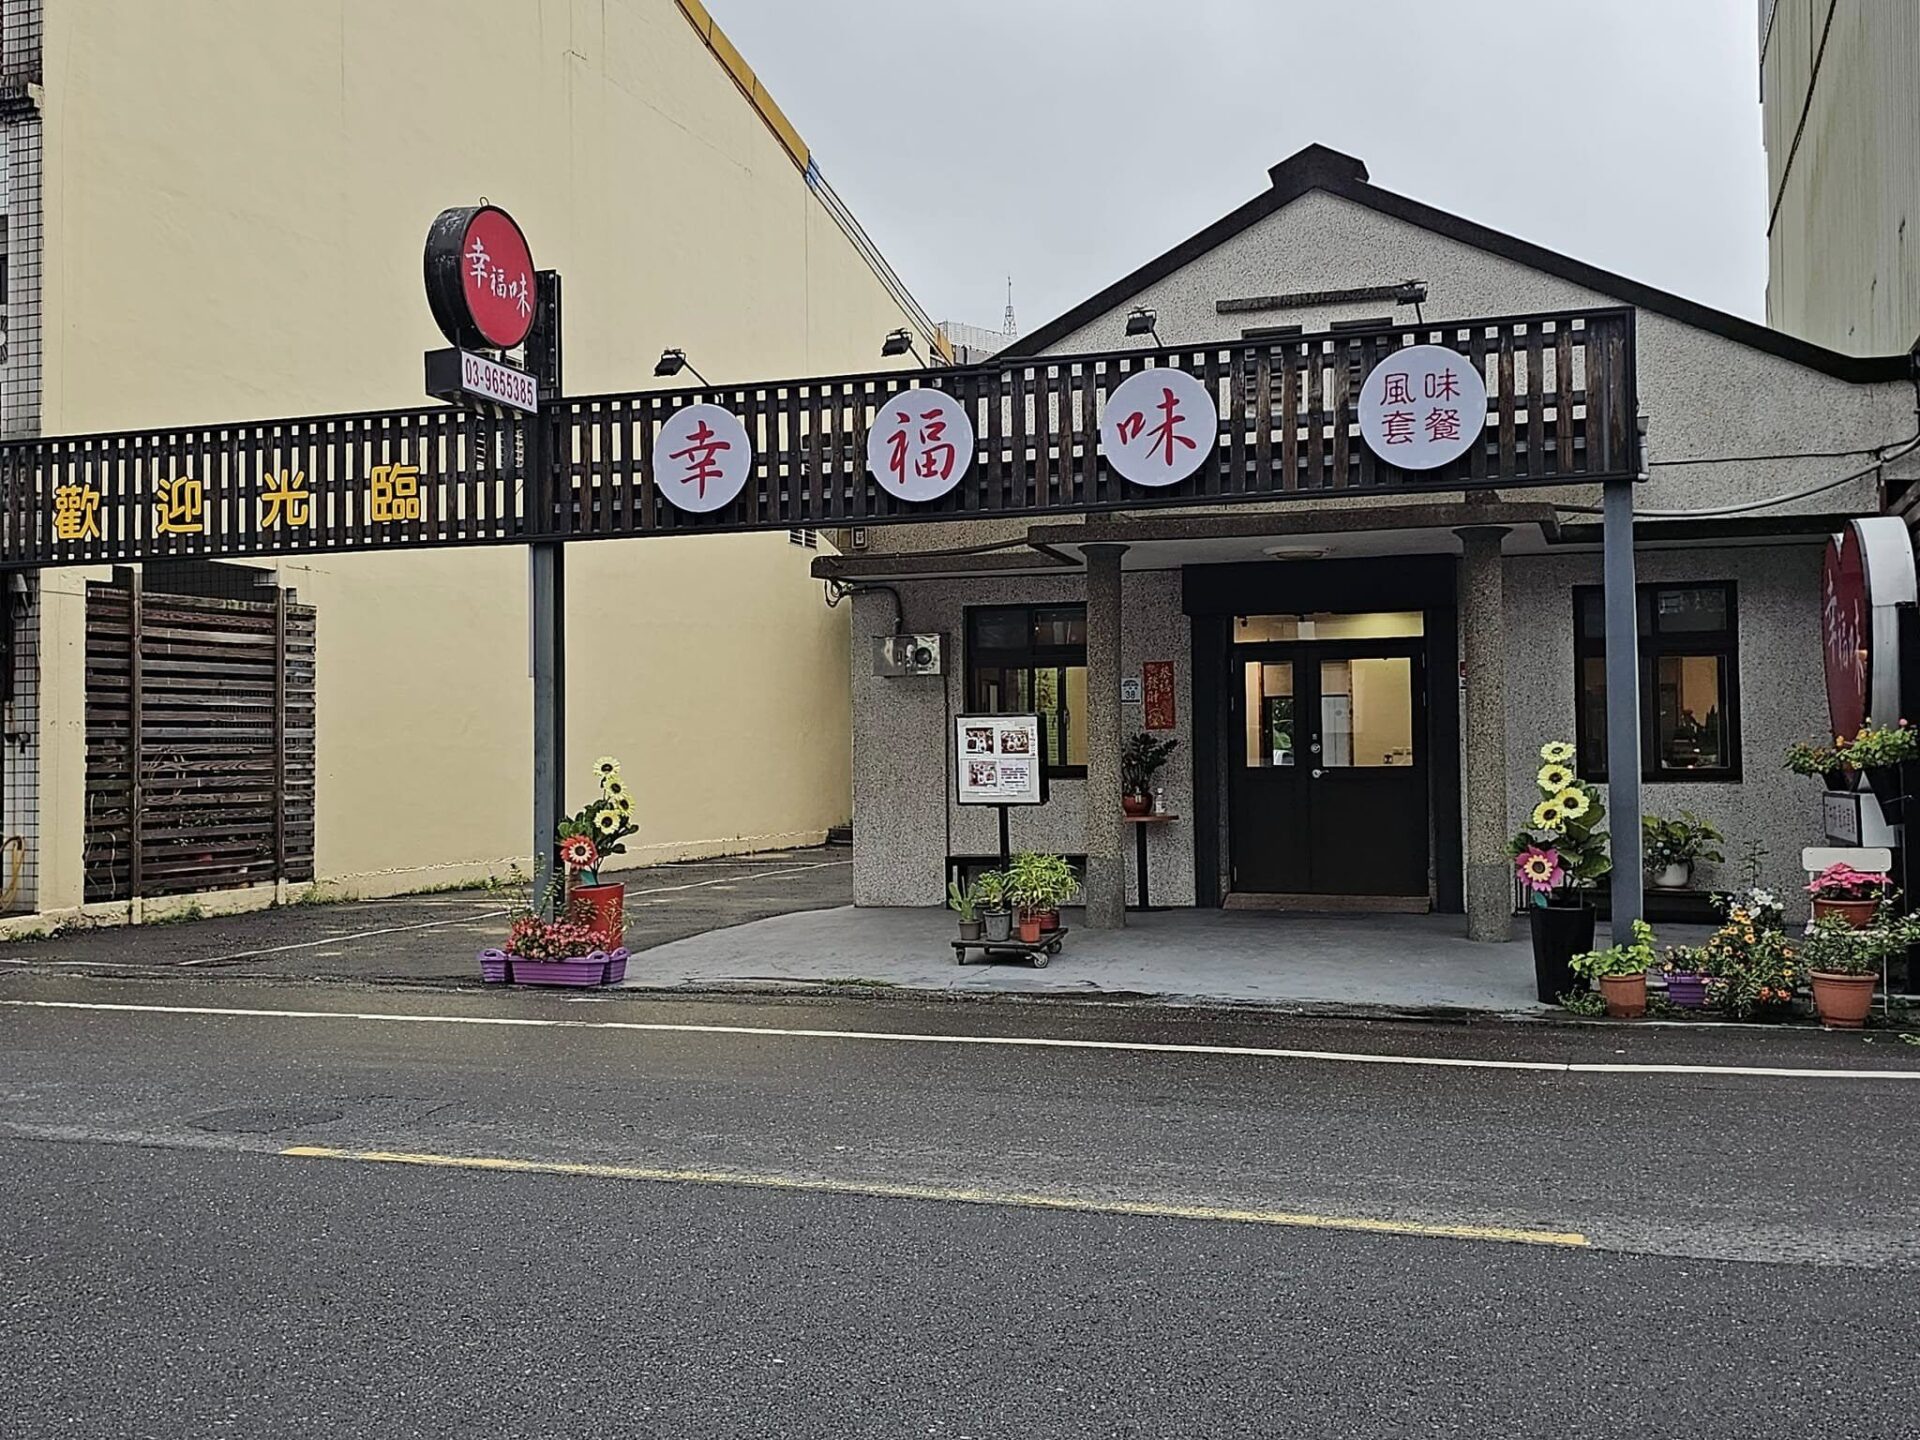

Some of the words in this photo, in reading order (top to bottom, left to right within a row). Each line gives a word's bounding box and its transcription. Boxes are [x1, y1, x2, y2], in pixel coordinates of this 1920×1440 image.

[465, 236, 532, 318] 幸福味
[465, 358, 533, 407] 03-9655385
[1380, 367, 1461, 406] 風味
[669, 420, 731, 500] 幸
[887, 408, 955, 484] 福
[1117, 387, 1196, 466] 味
[1381, 406, 1461, 445] 套餐
[53, 463, 420, 540] 歡迎光臨
[1124, 690, 1136, 699] 38
